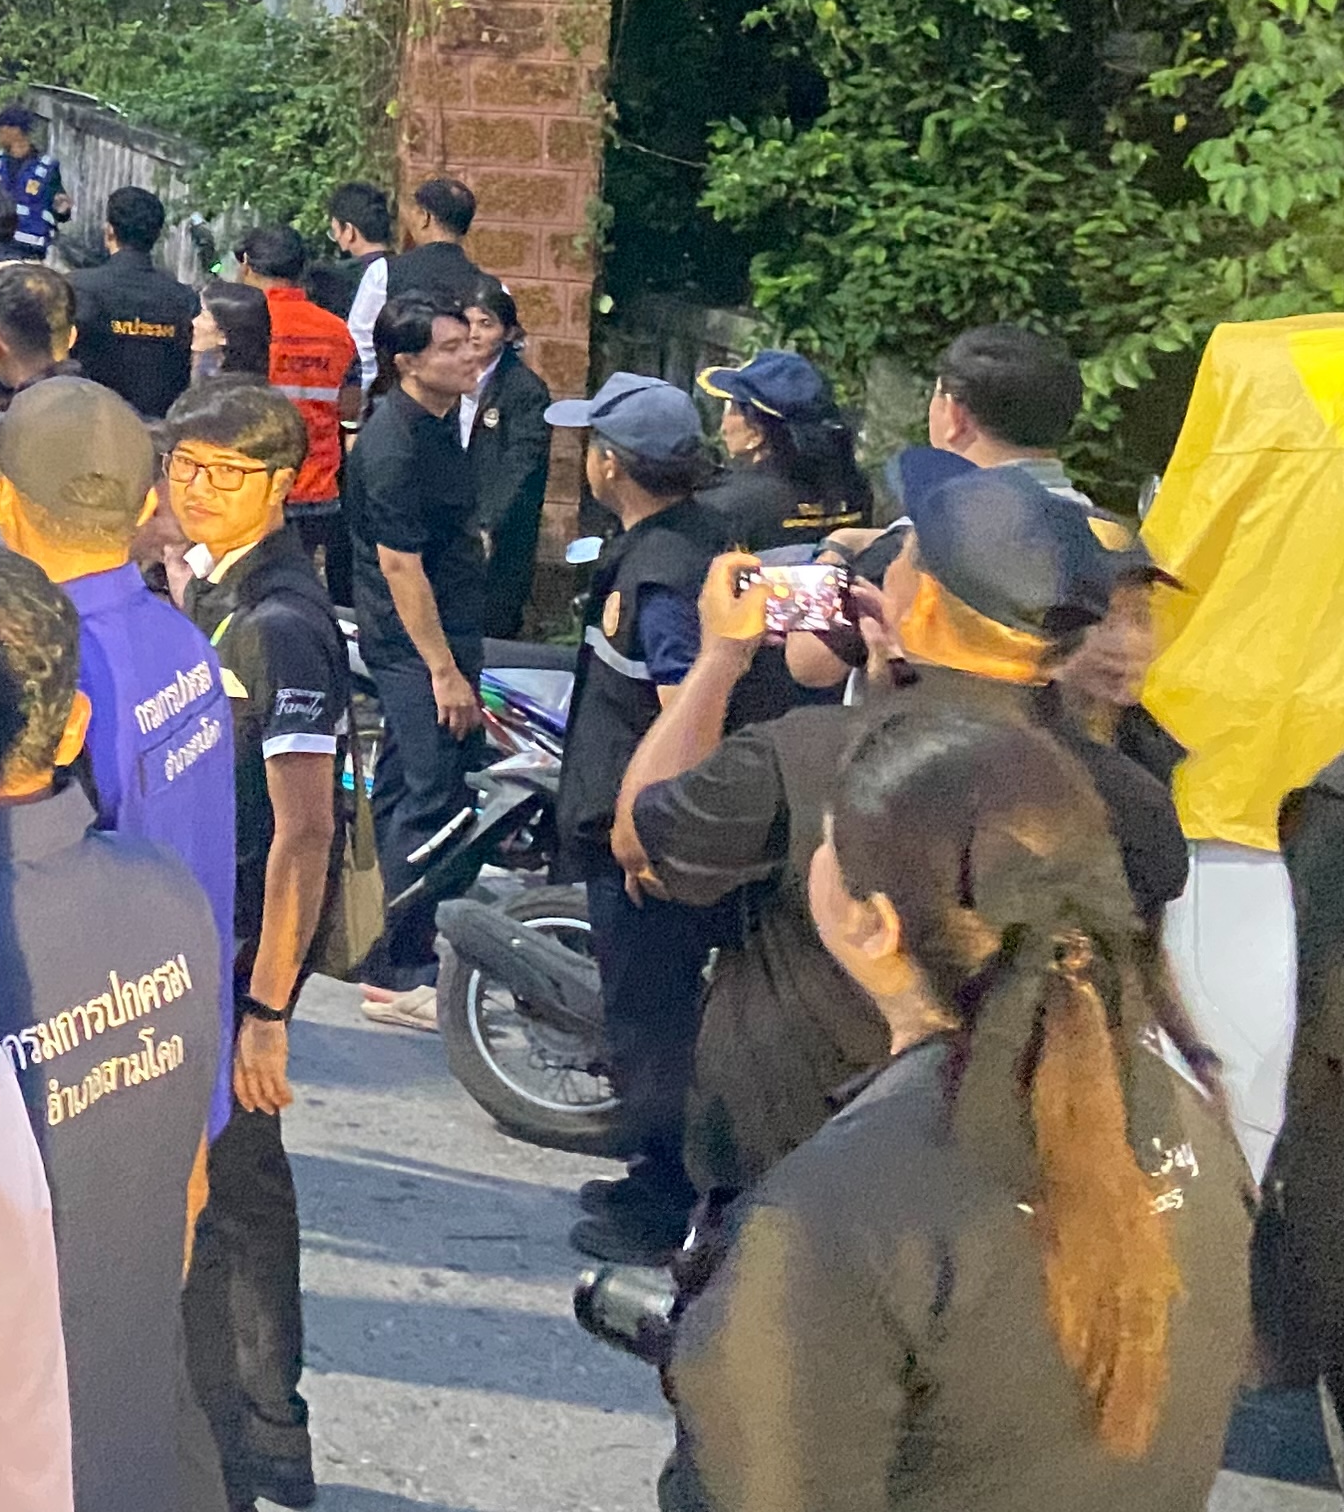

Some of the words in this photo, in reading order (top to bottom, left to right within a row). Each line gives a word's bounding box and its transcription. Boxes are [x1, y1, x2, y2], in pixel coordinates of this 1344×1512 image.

[1, 953, 192, 1070] กรมการปกครอง
[47, 1027, 184, 1125] อำเภอสามโคก
